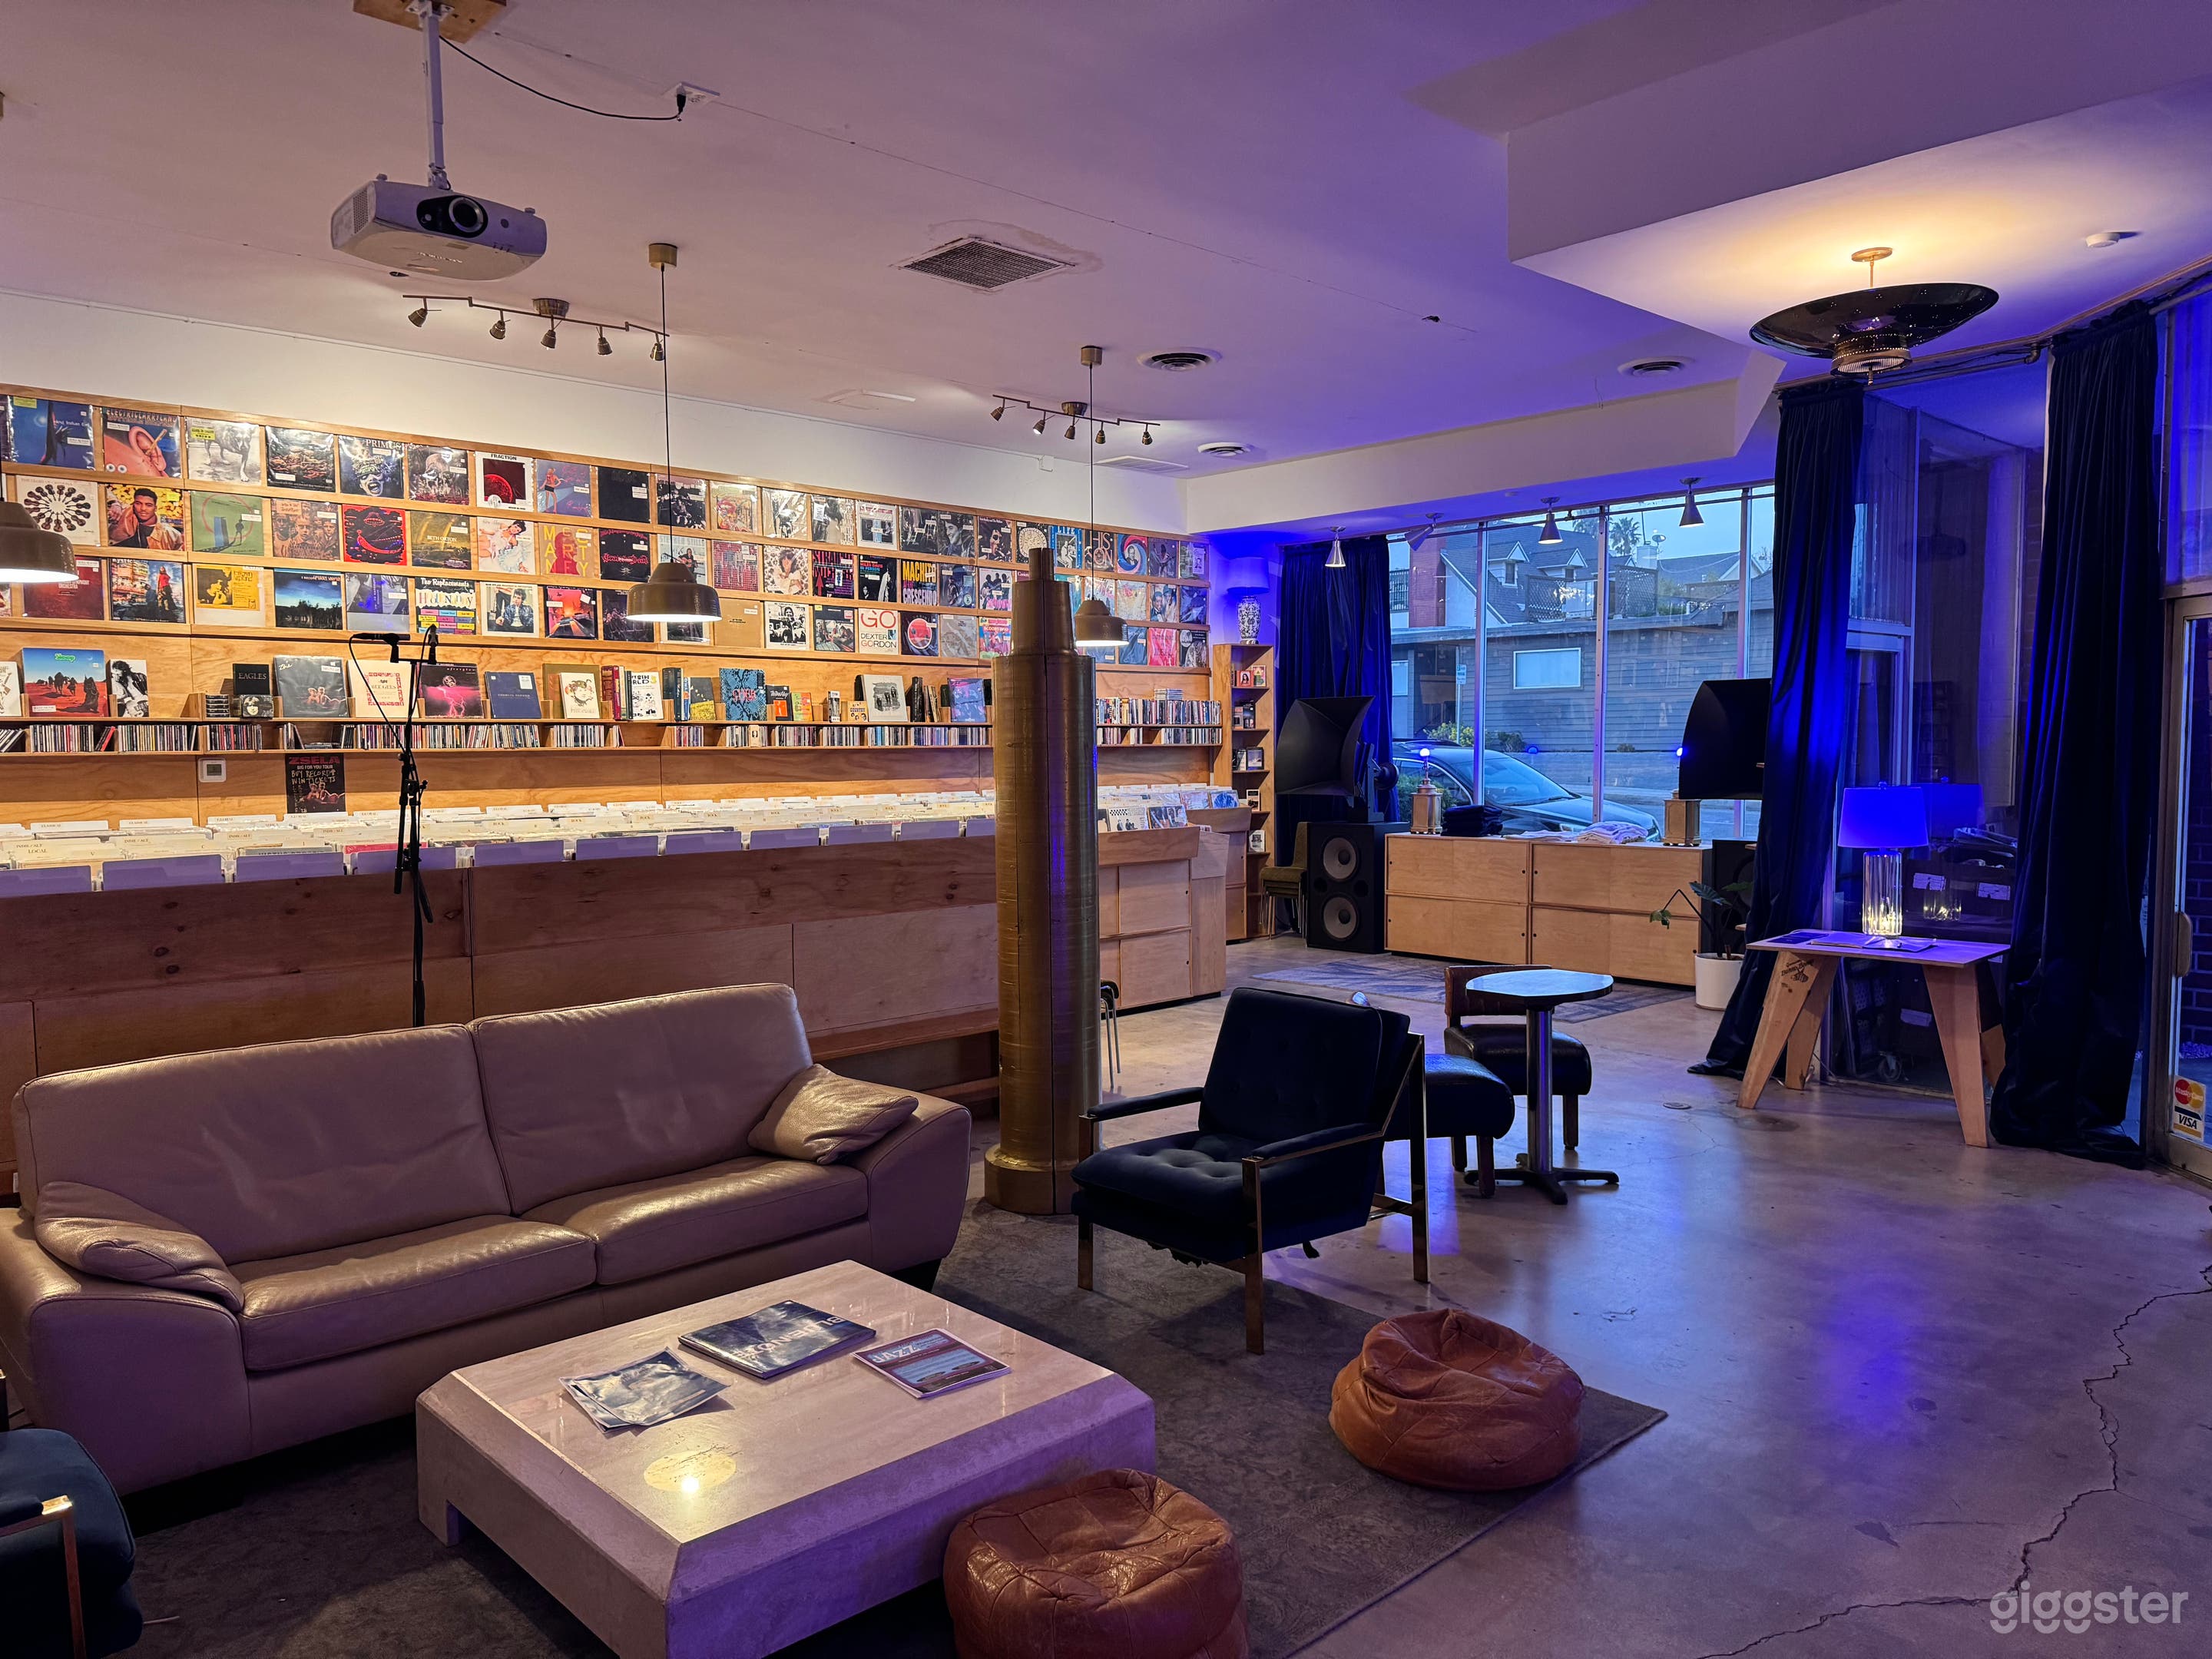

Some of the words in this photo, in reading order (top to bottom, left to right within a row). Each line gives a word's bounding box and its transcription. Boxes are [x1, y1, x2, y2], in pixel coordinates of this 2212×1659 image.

[366, 439, 402, 450] PRIMUS
[1058, 525, 1075, 535] LIFE
[1089, 530, 1111, 550] HIS
[1087, 547, 1113, 565] SON
[902, 561, 936, 582] MACHITO
[432, 578, 470, 588] Replacements
[902, 588, 937, 606] CRESCENDO
[861, 610, 896, 629] GO
[289, 756, 340, 765] ZSELA
[291, 770, 303, 778] BUY
[2178, 1114, 2197, 1130] VISA
[873, 1344, 922, 1364] JAZZ
